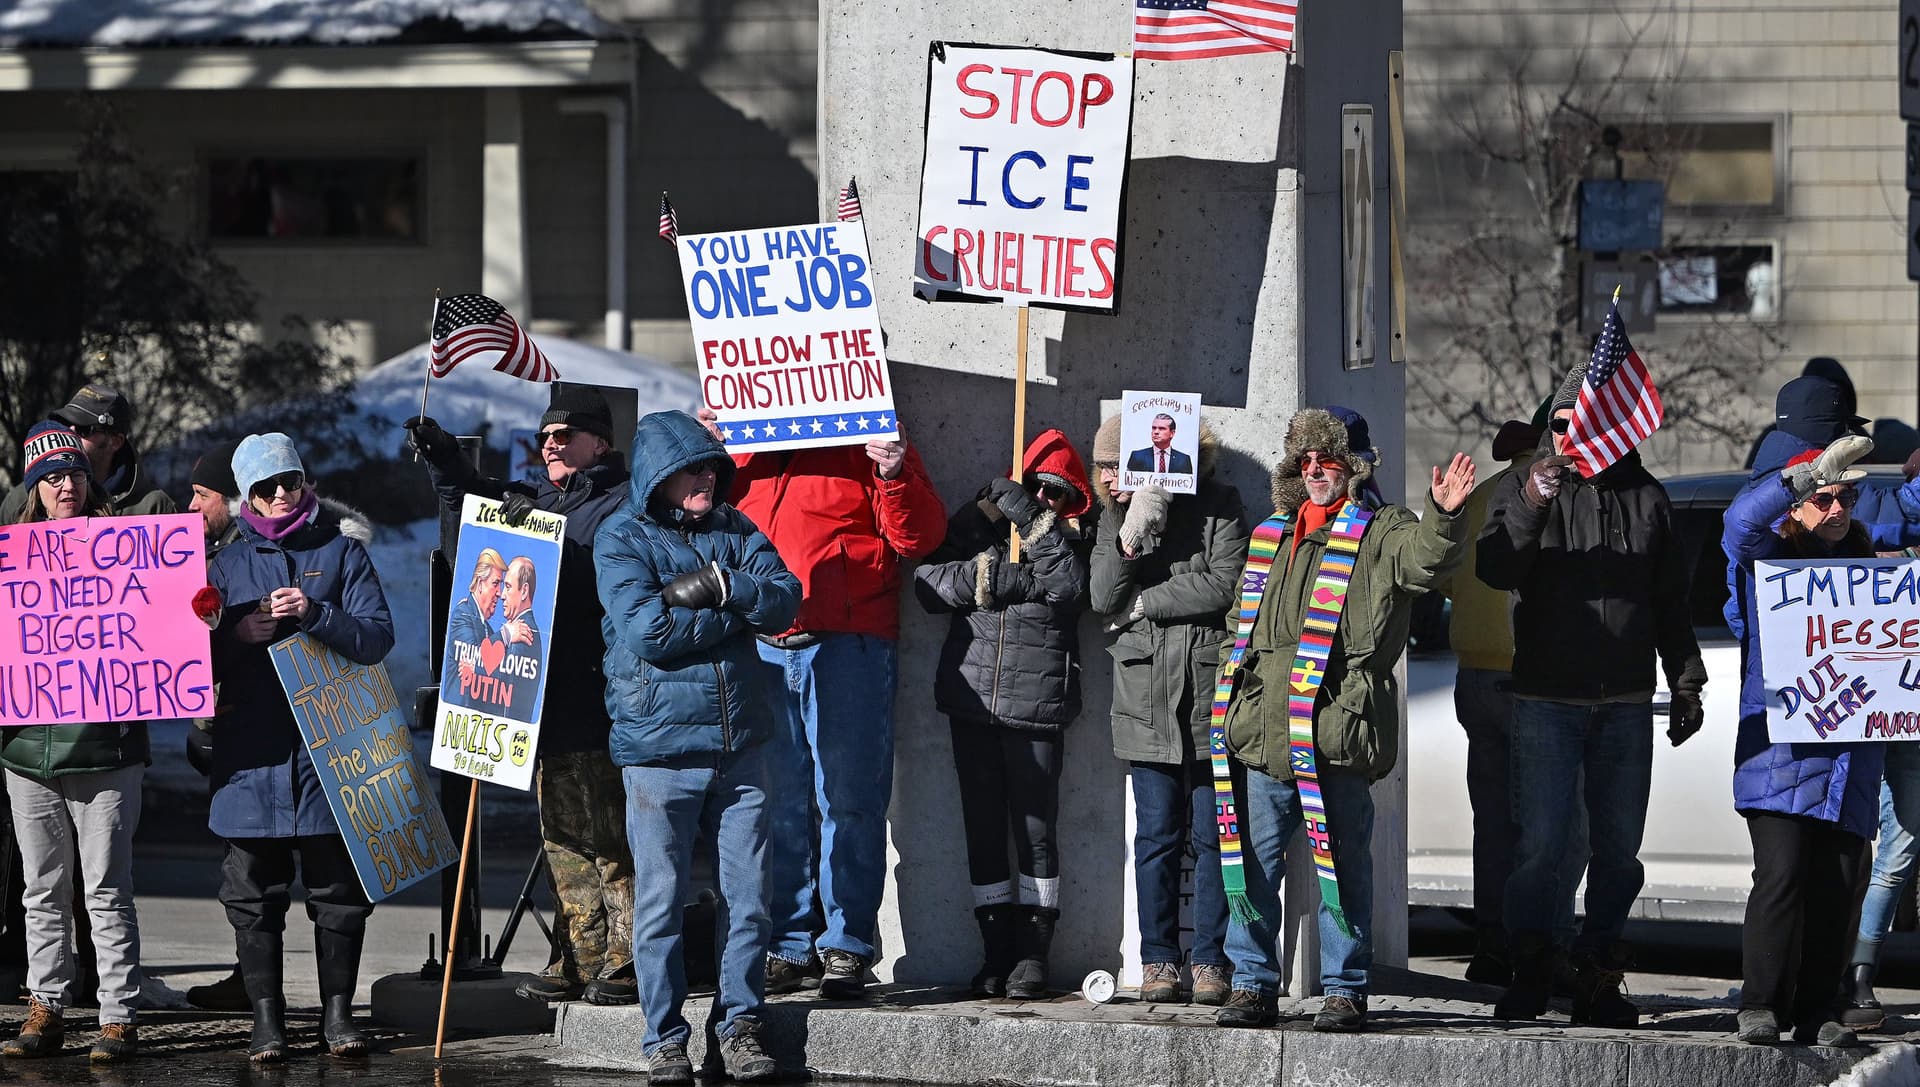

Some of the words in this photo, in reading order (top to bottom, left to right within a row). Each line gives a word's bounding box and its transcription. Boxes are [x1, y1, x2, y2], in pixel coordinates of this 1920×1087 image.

[956, 63, 1114, 129] STOP
[957, 145, 1094, 212] ICE
[687, 235, 750, 267] YOU
[763, 226, 841, 261] HAVE
[924, 225, 1116, 299] CRUELTIES
[691, 264, 779, 320] ONE
[784, 253, 873, 313] JOB
[702, 334, 812, 370] FOLLOW
[820, 328, 876, 360] THE
[704, 359, 885, 410] CONSTITUTION
[25, 432, 80, 465] PATRIO
[476, 503, 497, 522] ICE
[0, 533, 17, 572] E
[27, 528, 79, 573] ARE
[92, 524, 195, 570] GOING
[2, 580, 41, 609] TO
[51, 575, 113, 612] NEED
[120, 572, 151, 605] A
[1765, 564, 1920, 611] IMPEA
[19, 612, 144, 656] BIGGER
[1806, 614, 1920, 657] HEGSE
[454, 640, 484, 668] TRUM
[500, 654, 538, 679] LOVES
[460, 672, 513, 708] PUTIN
[1776, 654, 1847, 720] DUI
[1805, 675, 1877, 740] HIRE
[441, 710, 508, 762] NAZIS
[1865, 711, 1920, 738] MURD
[327, 744, 367, 784] the
